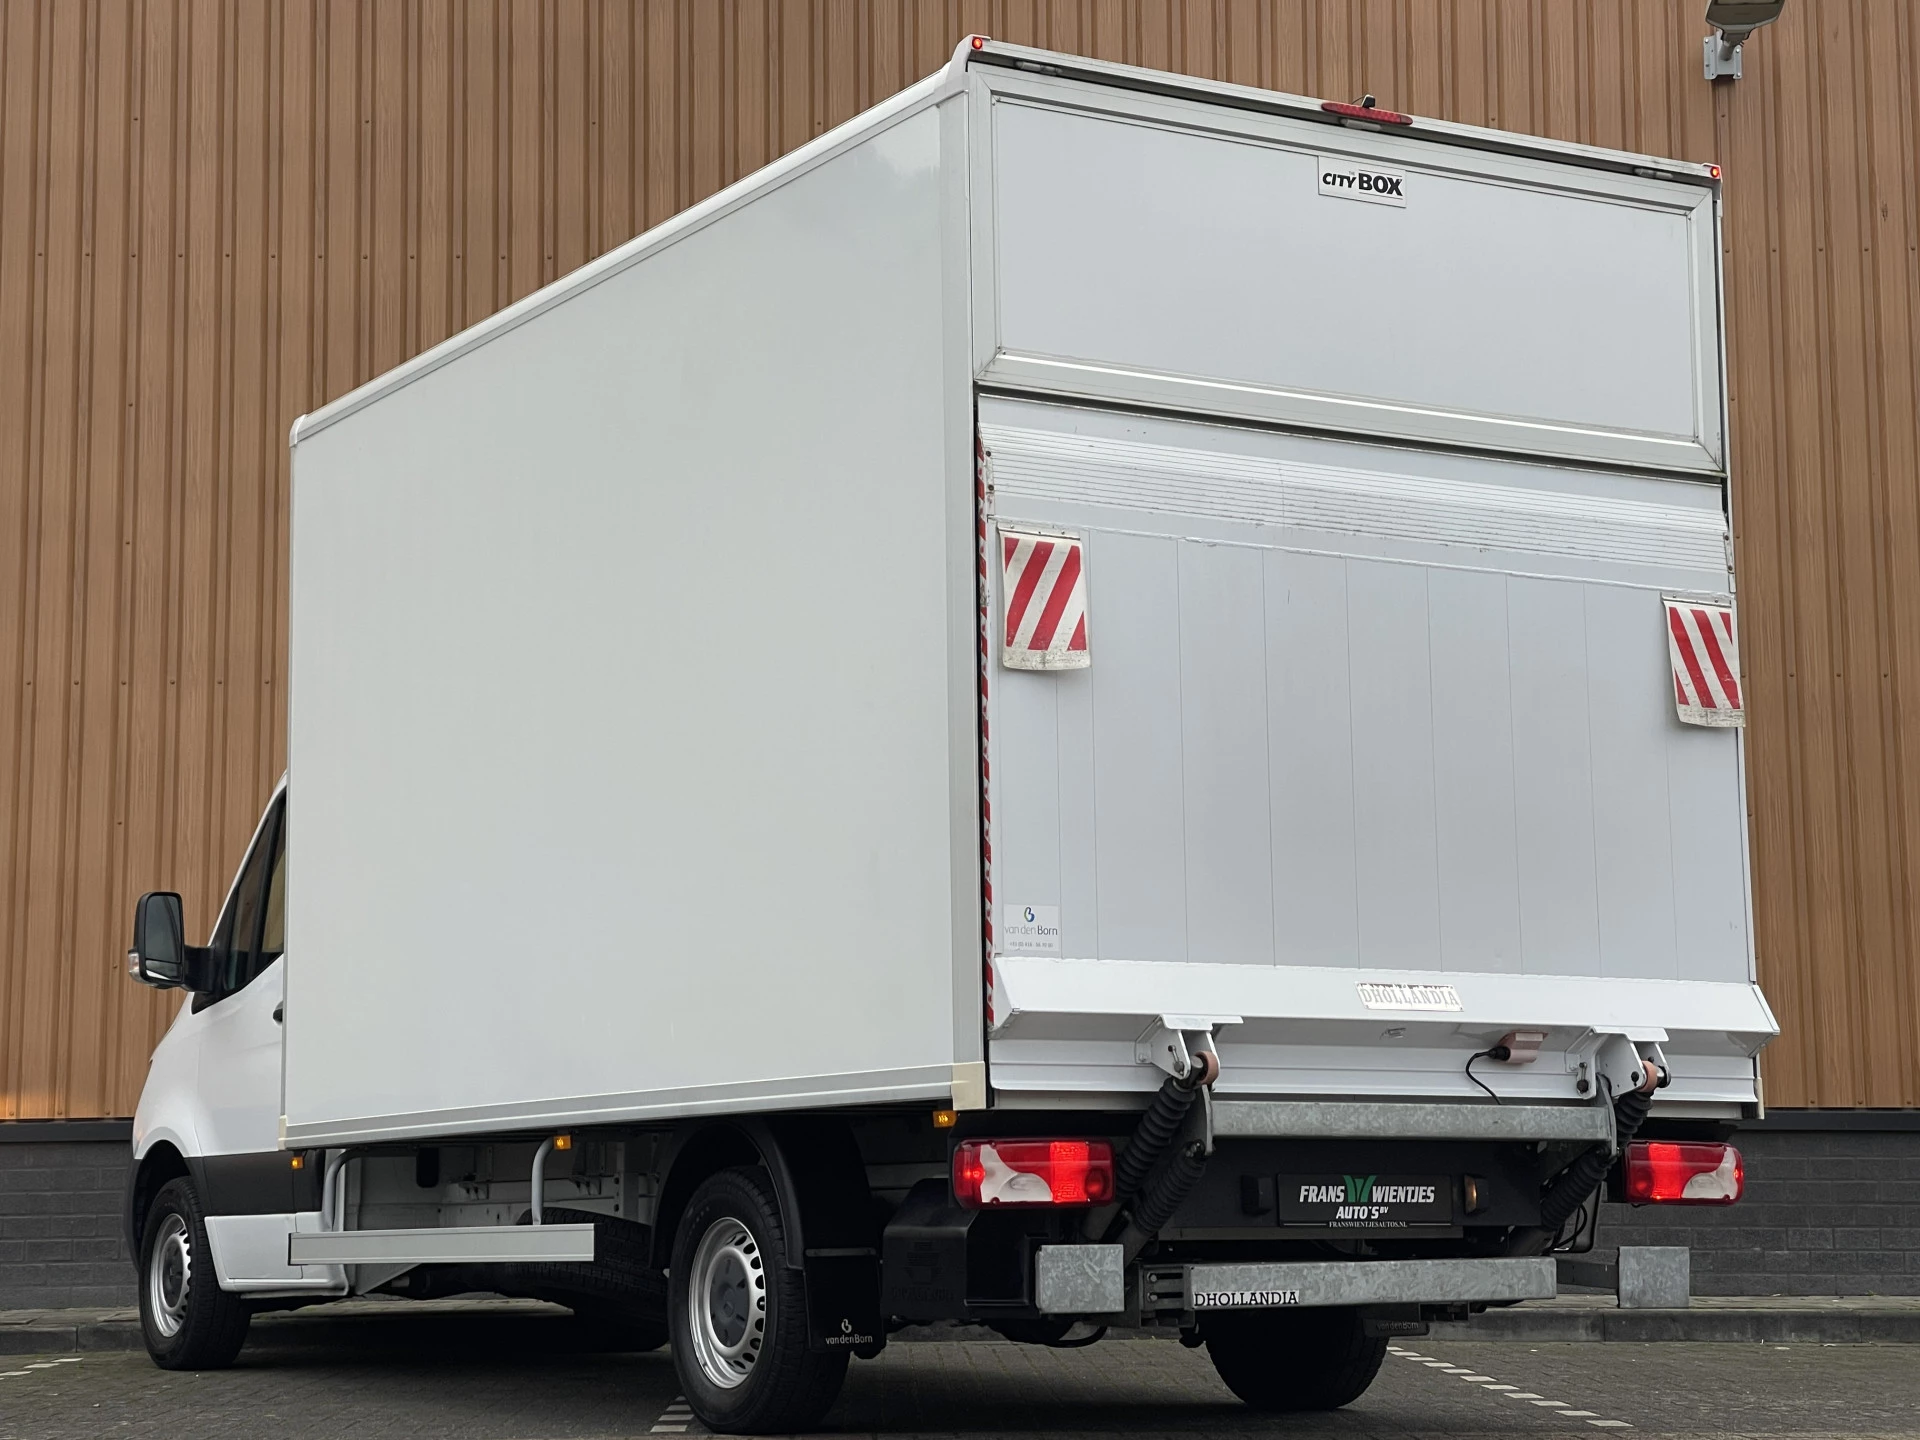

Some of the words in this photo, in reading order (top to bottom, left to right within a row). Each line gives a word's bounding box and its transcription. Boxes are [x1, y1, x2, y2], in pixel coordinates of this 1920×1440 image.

[1322, 172, 1357, 188] CITY
[1358, 172, 1403, 197] BOX
[1037, 924, 1058, 936] Born
[1360, 987, 1460, 1007] DHOLLANDIA
[1300, 1185, 1345, 1203] FRANS
[1372, 1186, 1435, 1203] WIENTJES
[1194, 1291, 1299, 1307] DHOLLANDIA
